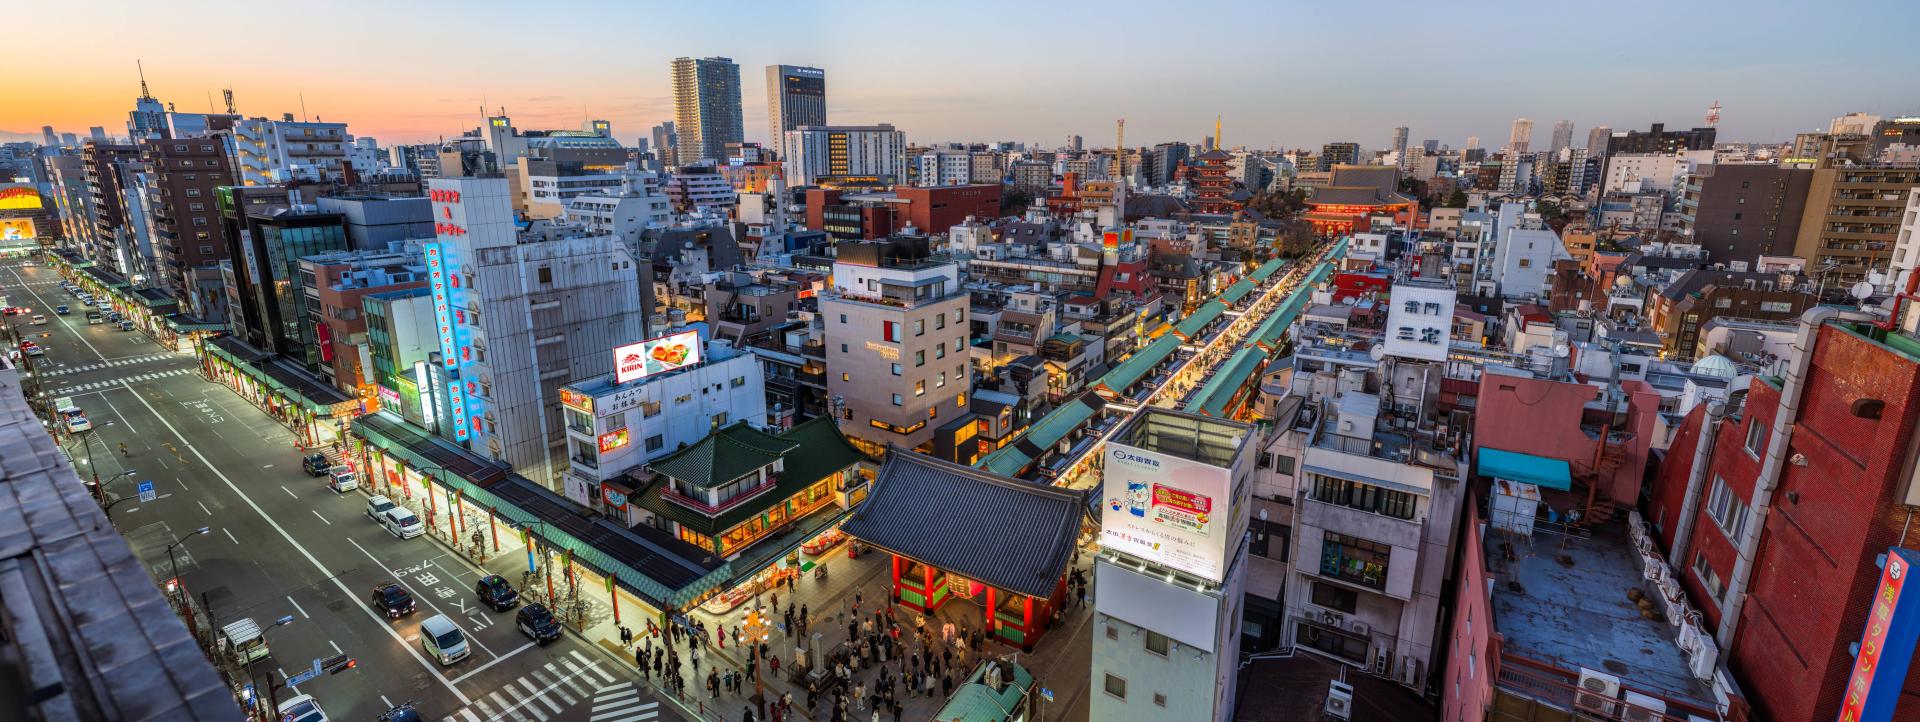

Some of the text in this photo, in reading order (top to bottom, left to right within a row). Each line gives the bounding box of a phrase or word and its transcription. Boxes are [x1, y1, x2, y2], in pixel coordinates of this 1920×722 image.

[1404, 300, 1440, 315] 雷門
[621, 362, 643, 374] KIRIN
[614, 388, 642, 402] あんみつ
[451, 385, 466, 437] カラオケ館
